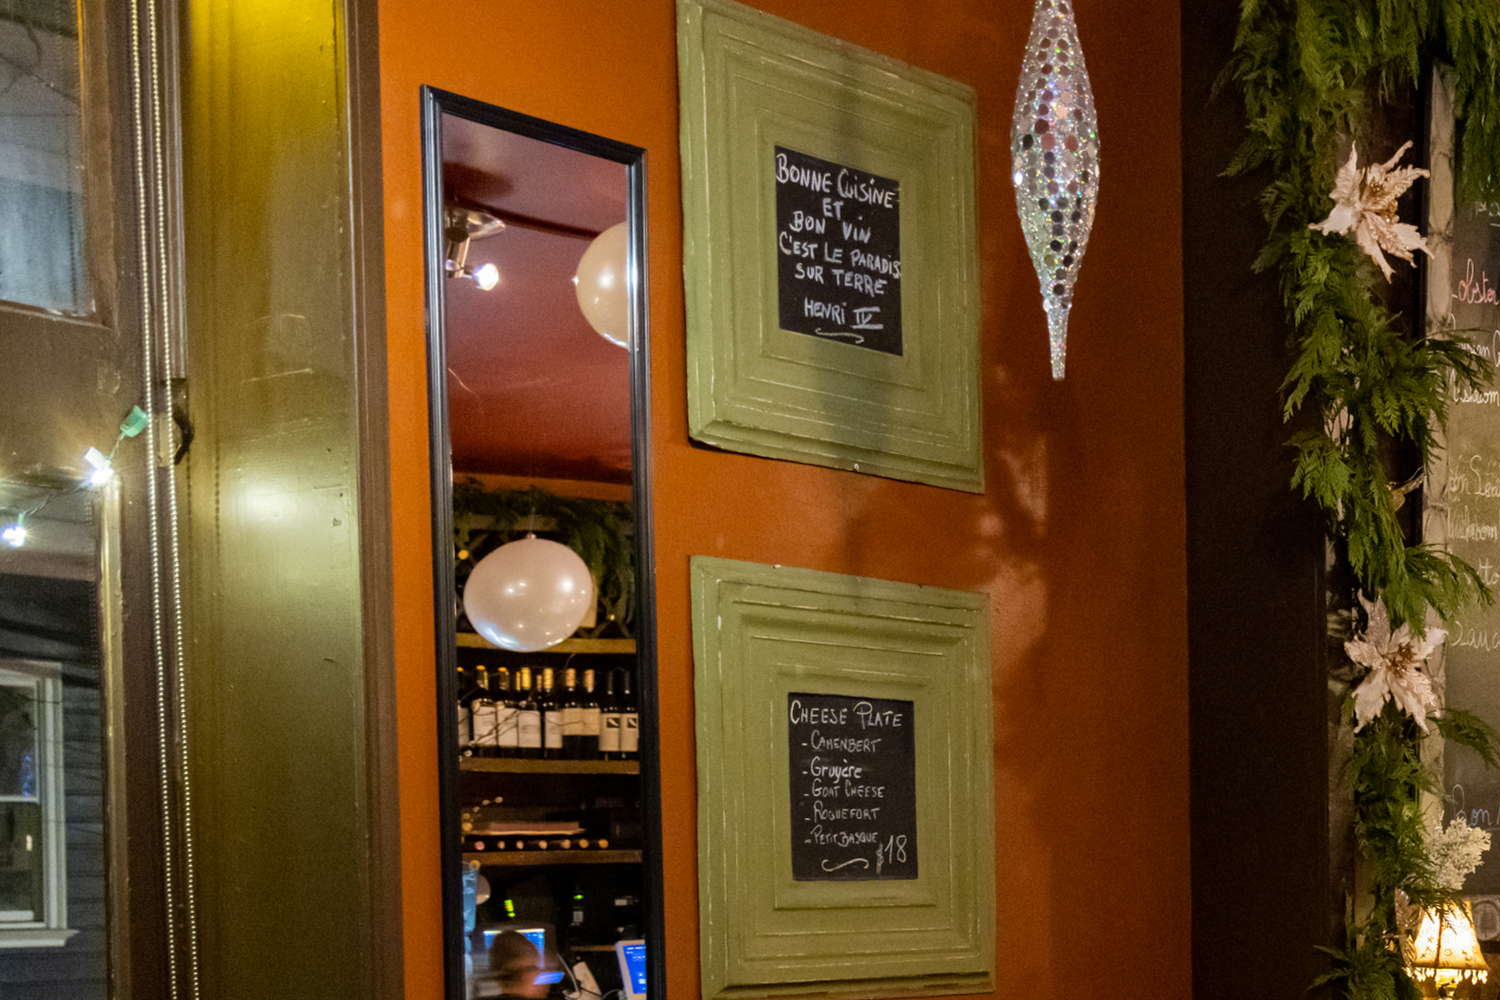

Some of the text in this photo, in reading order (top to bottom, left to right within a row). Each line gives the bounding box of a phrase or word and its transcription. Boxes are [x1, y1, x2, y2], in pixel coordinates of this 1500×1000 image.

[789, 211, 826, 234] BON
[822, 198, 844, 221] ET
[779, 231, 818, 260] C'EST
[824, 241, 843, 264] LE
[794, 262, 888, 298] SUR TERRE
[1452, 258, 1499, 305] obster
[851, 306, 884, 330] IV
[790, 700, 902, 730] CHEESE PLATE
[810, 756, 863, 784] Gruyère
[812, 778, 885, 799] GOAT CHEESE
